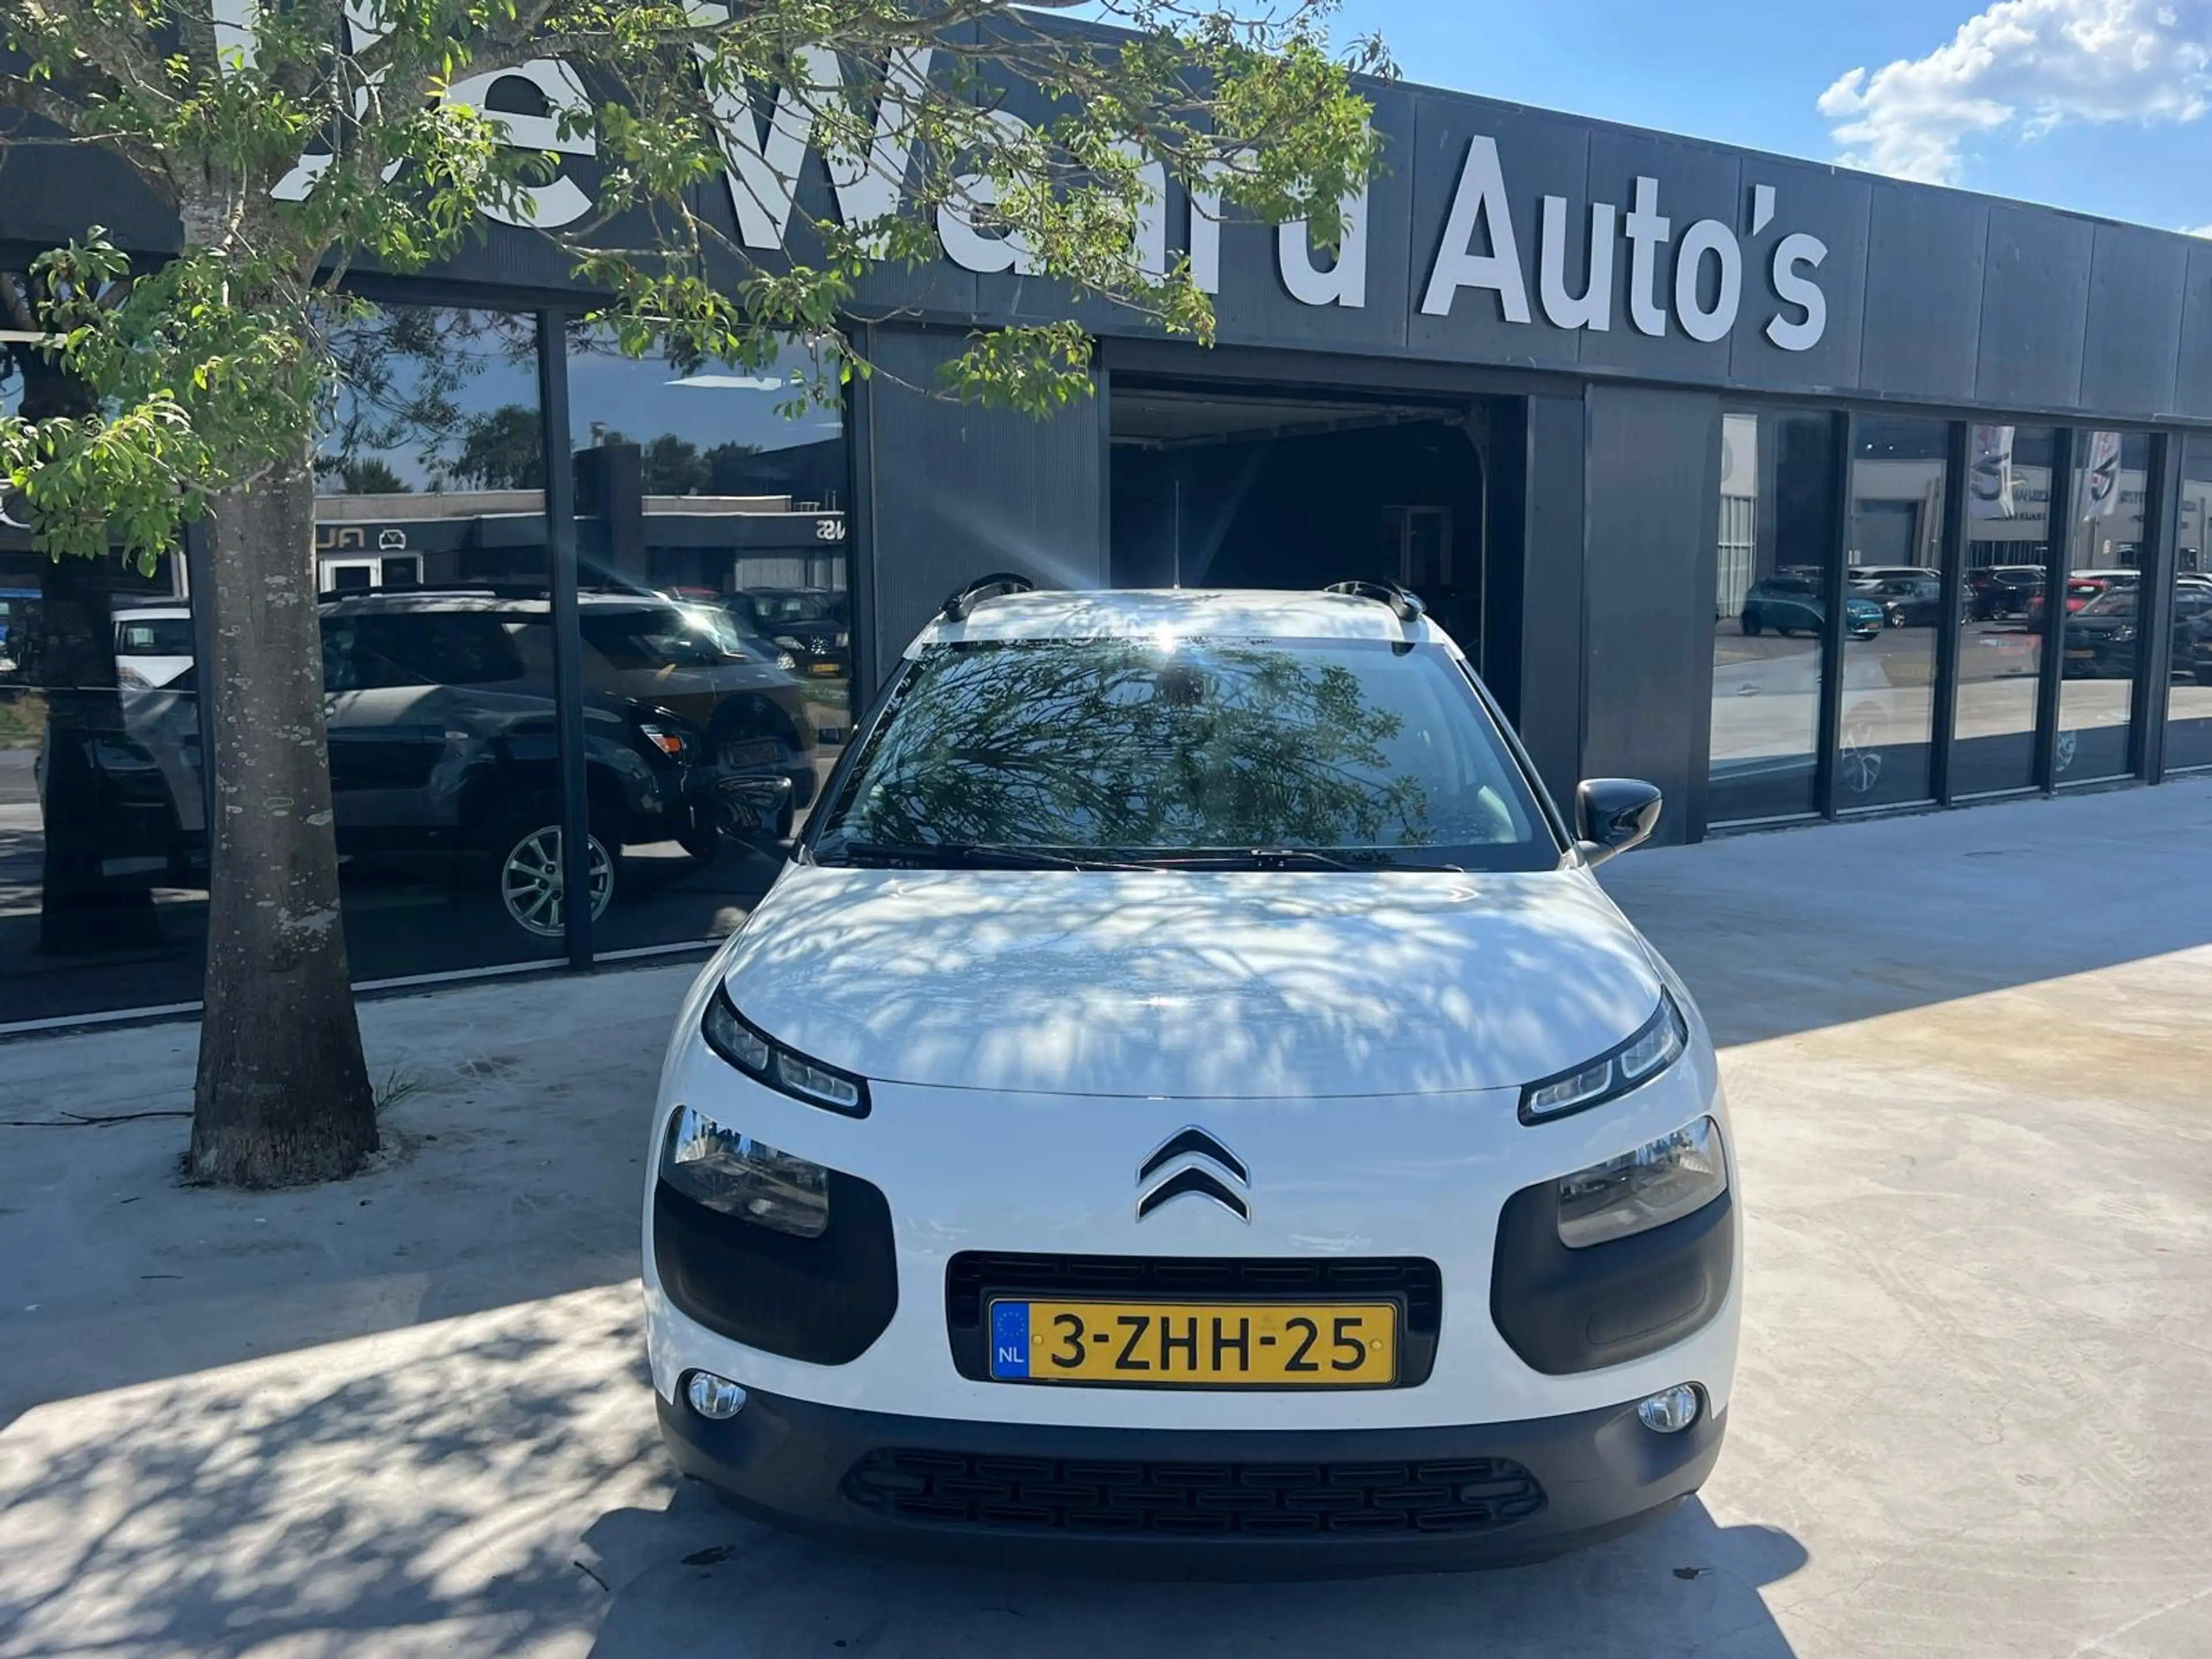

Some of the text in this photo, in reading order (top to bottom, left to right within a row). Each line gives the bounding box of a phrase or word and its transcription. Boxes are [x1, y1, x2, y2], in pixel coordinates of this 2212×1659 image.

[1421, 135, 1828, 351] Auto's
[998, 1346, 1025, 1363] NL
[1051, 1313, 1367, 1372] 3-ZHH-25
